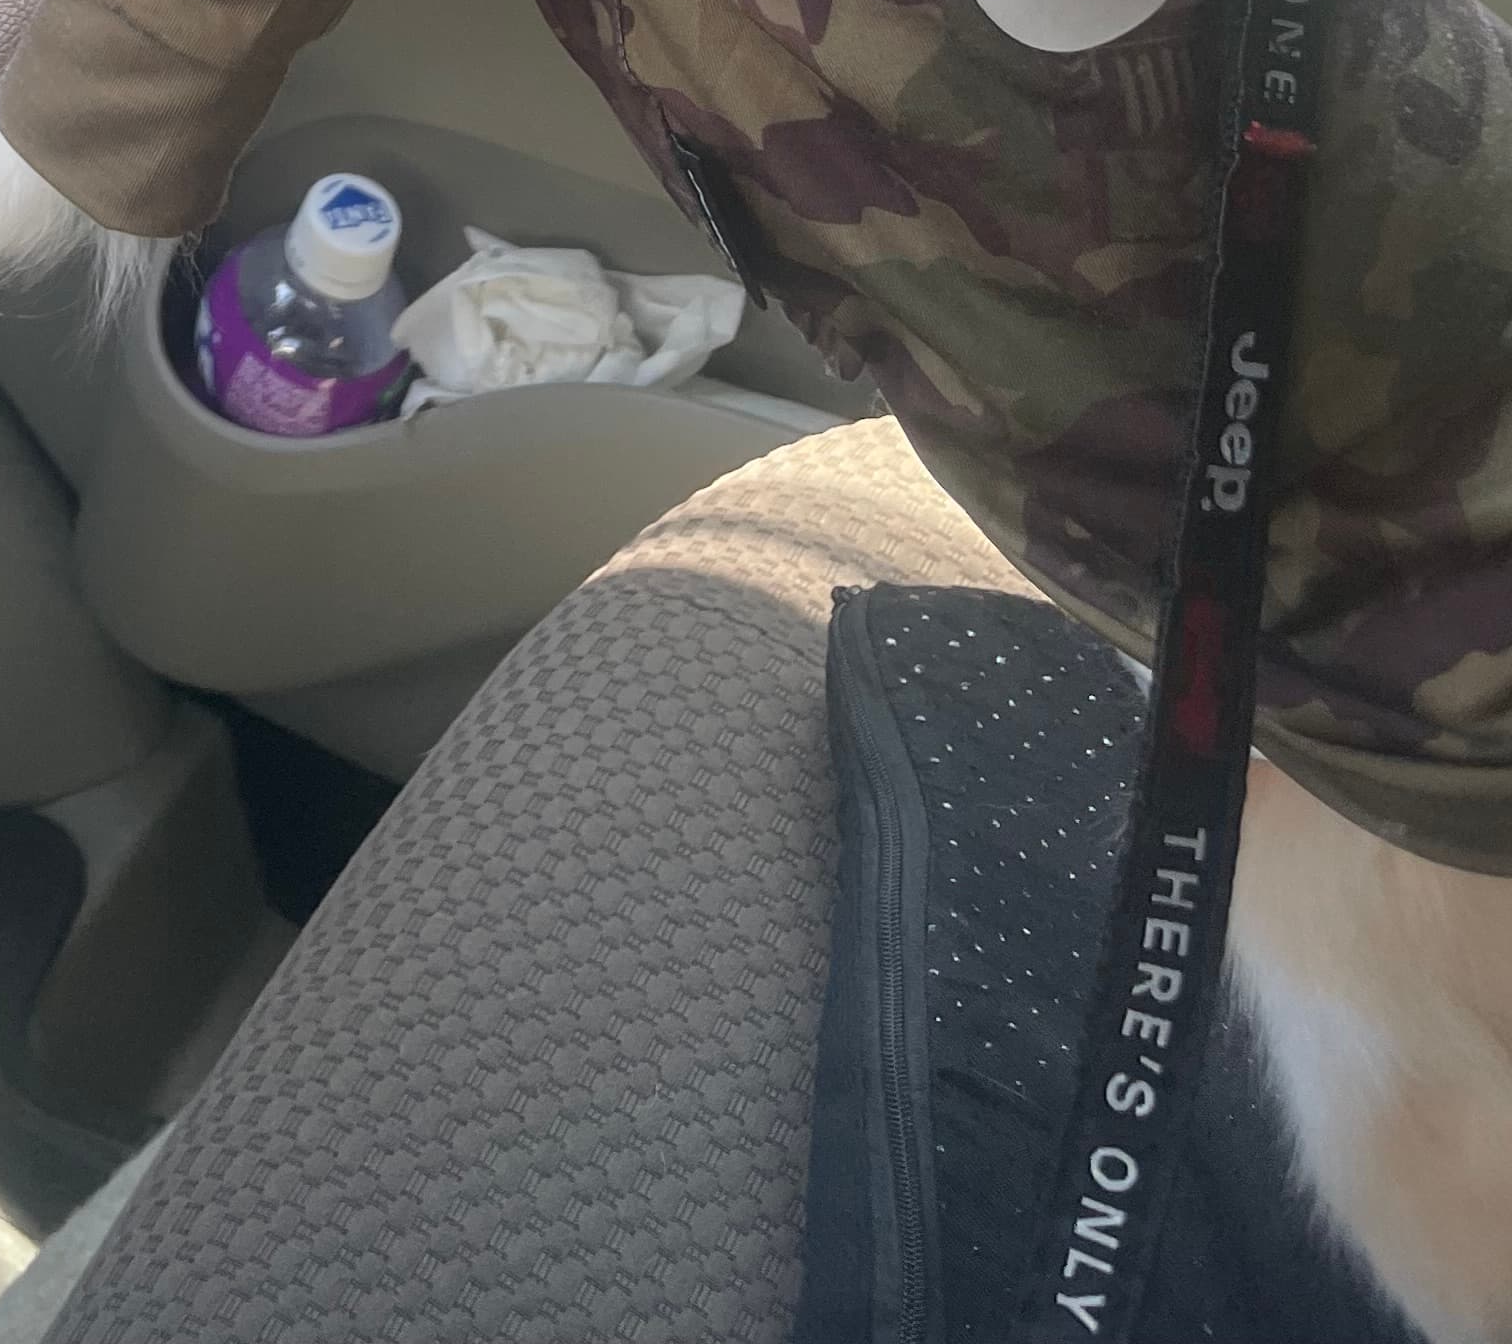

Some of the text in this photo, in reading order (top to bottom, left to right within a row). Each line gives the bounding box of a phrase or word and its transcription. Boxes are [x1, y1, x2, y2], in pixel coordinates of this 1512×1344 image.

[1204, 329, 1271, 512] Jeep
[1055, 826, 1208, 1336] THERE'S ONLY
